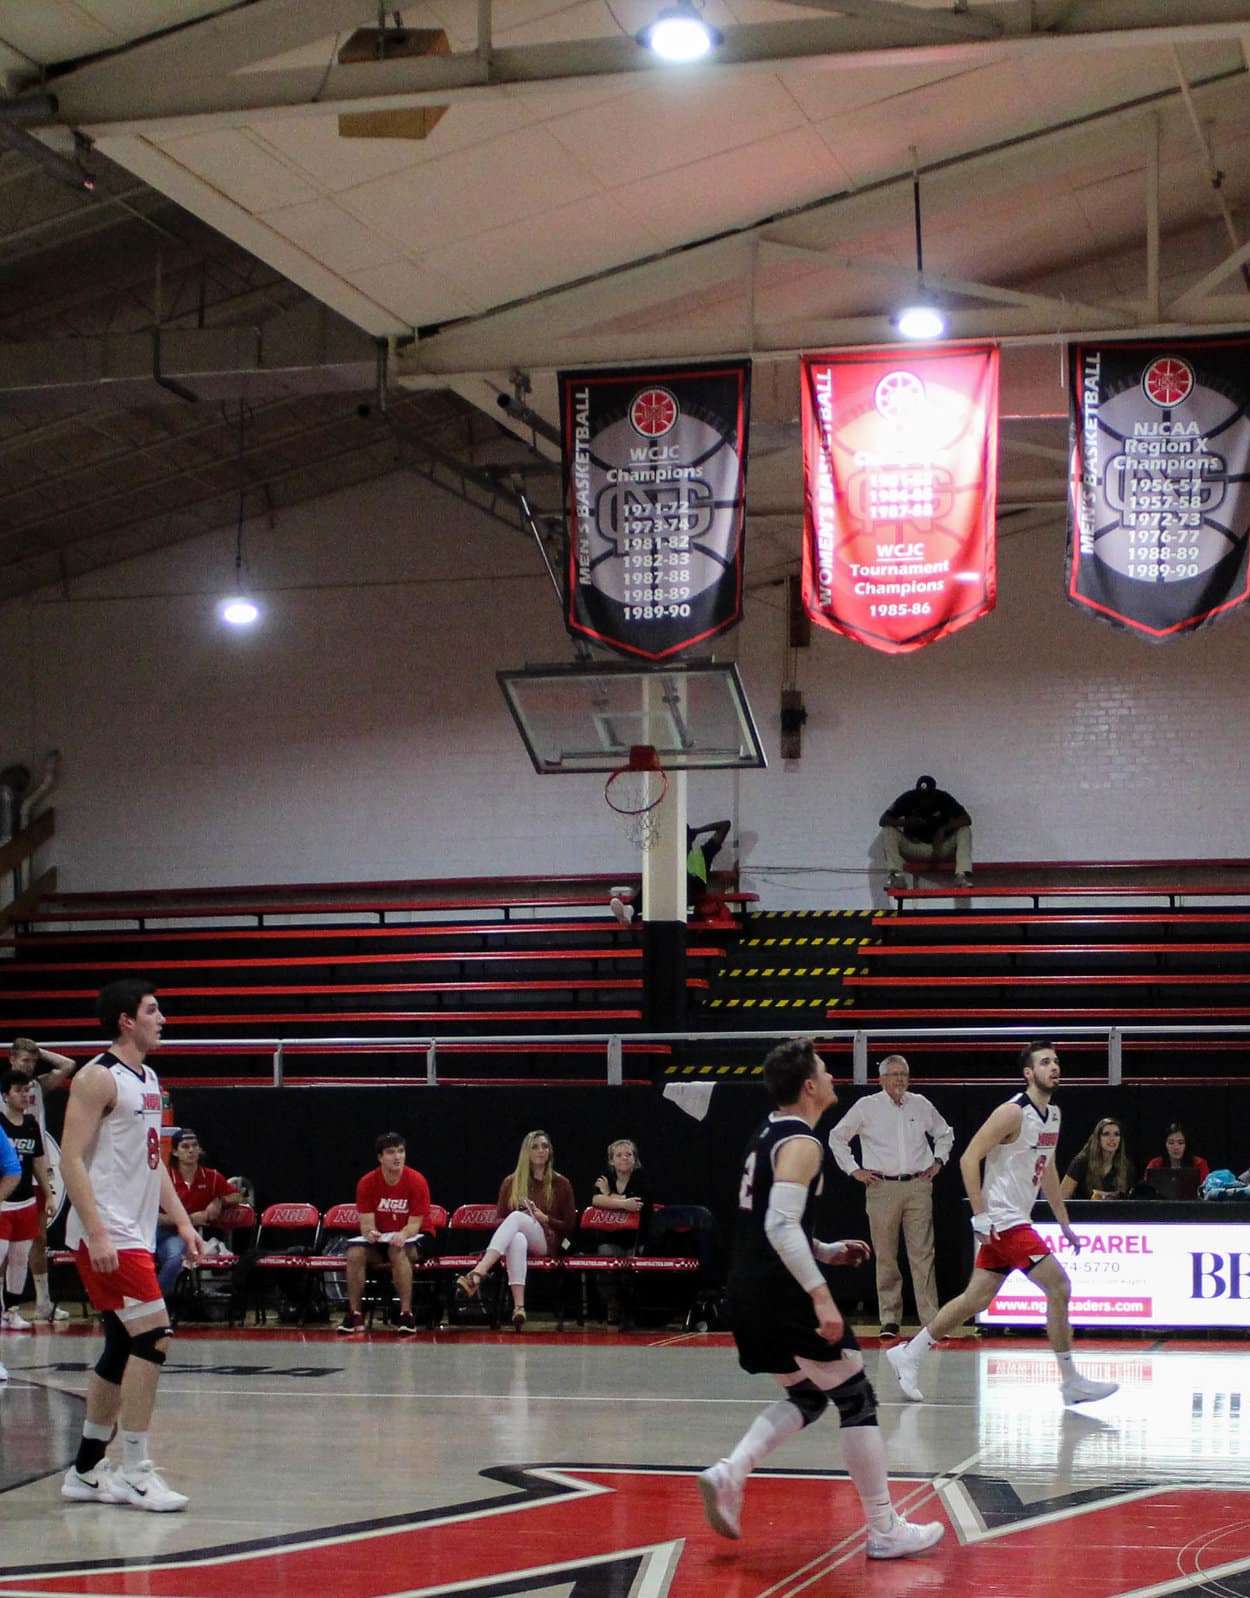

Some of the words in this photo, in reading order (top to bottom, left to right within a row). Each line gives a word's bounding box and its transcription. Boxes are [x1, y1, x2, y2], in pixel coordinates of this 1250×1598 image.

[1081, 352, 1101, 488] BASKETBALL
[1134, 421, 1200, 436] NJCAA
[575, 387, 590, 518] BASKETBALL
[630, 446, 680, 460] WCJC
[1125, 438, 1191, 455] Region
[1195, 438, 1208, 452] X
[1113, 455, 1219, 474] Champions
[606, 466, 704, 484] Champions
[1130, 478, 1202, 492] 1956-57
[623, 502, 690, 517] 1971-72
[623, 518, 690, 534] 1973-74
[1080, 494, 1096, 554] MEN'S
[1129, 513, 1201, 527] 1972-73
[623, 536, 690, 550] 1981-82
[1128, 530, 1200, 543] 1976-77
[818, 506, 834, 607] WOMEN'S
[877, 543, 924, 557] WCJC
[1128, 547, 1200, 560] 1988-89
[623, 553, 690, 567] 1982-83
[850, 560, 949, 577] Tournament
[1127, 563, 1199, 577] 1989-90
[623, 570, 690, 585] 1987-88
[623, 588, 690, 602] 1988-89
[854, 580, 944, 597] Champions
[623, 605, 690, 620] 1989-90
[870, 603, 931, 617] 1985-86
[147, 1127, 160, 1170] 8
[379, 1199, 408, 1210] NGU
[1063, 1262, 1120, 1273] 74-5770
[996, 1300, 1144, 1313] www.ngsaders.com
